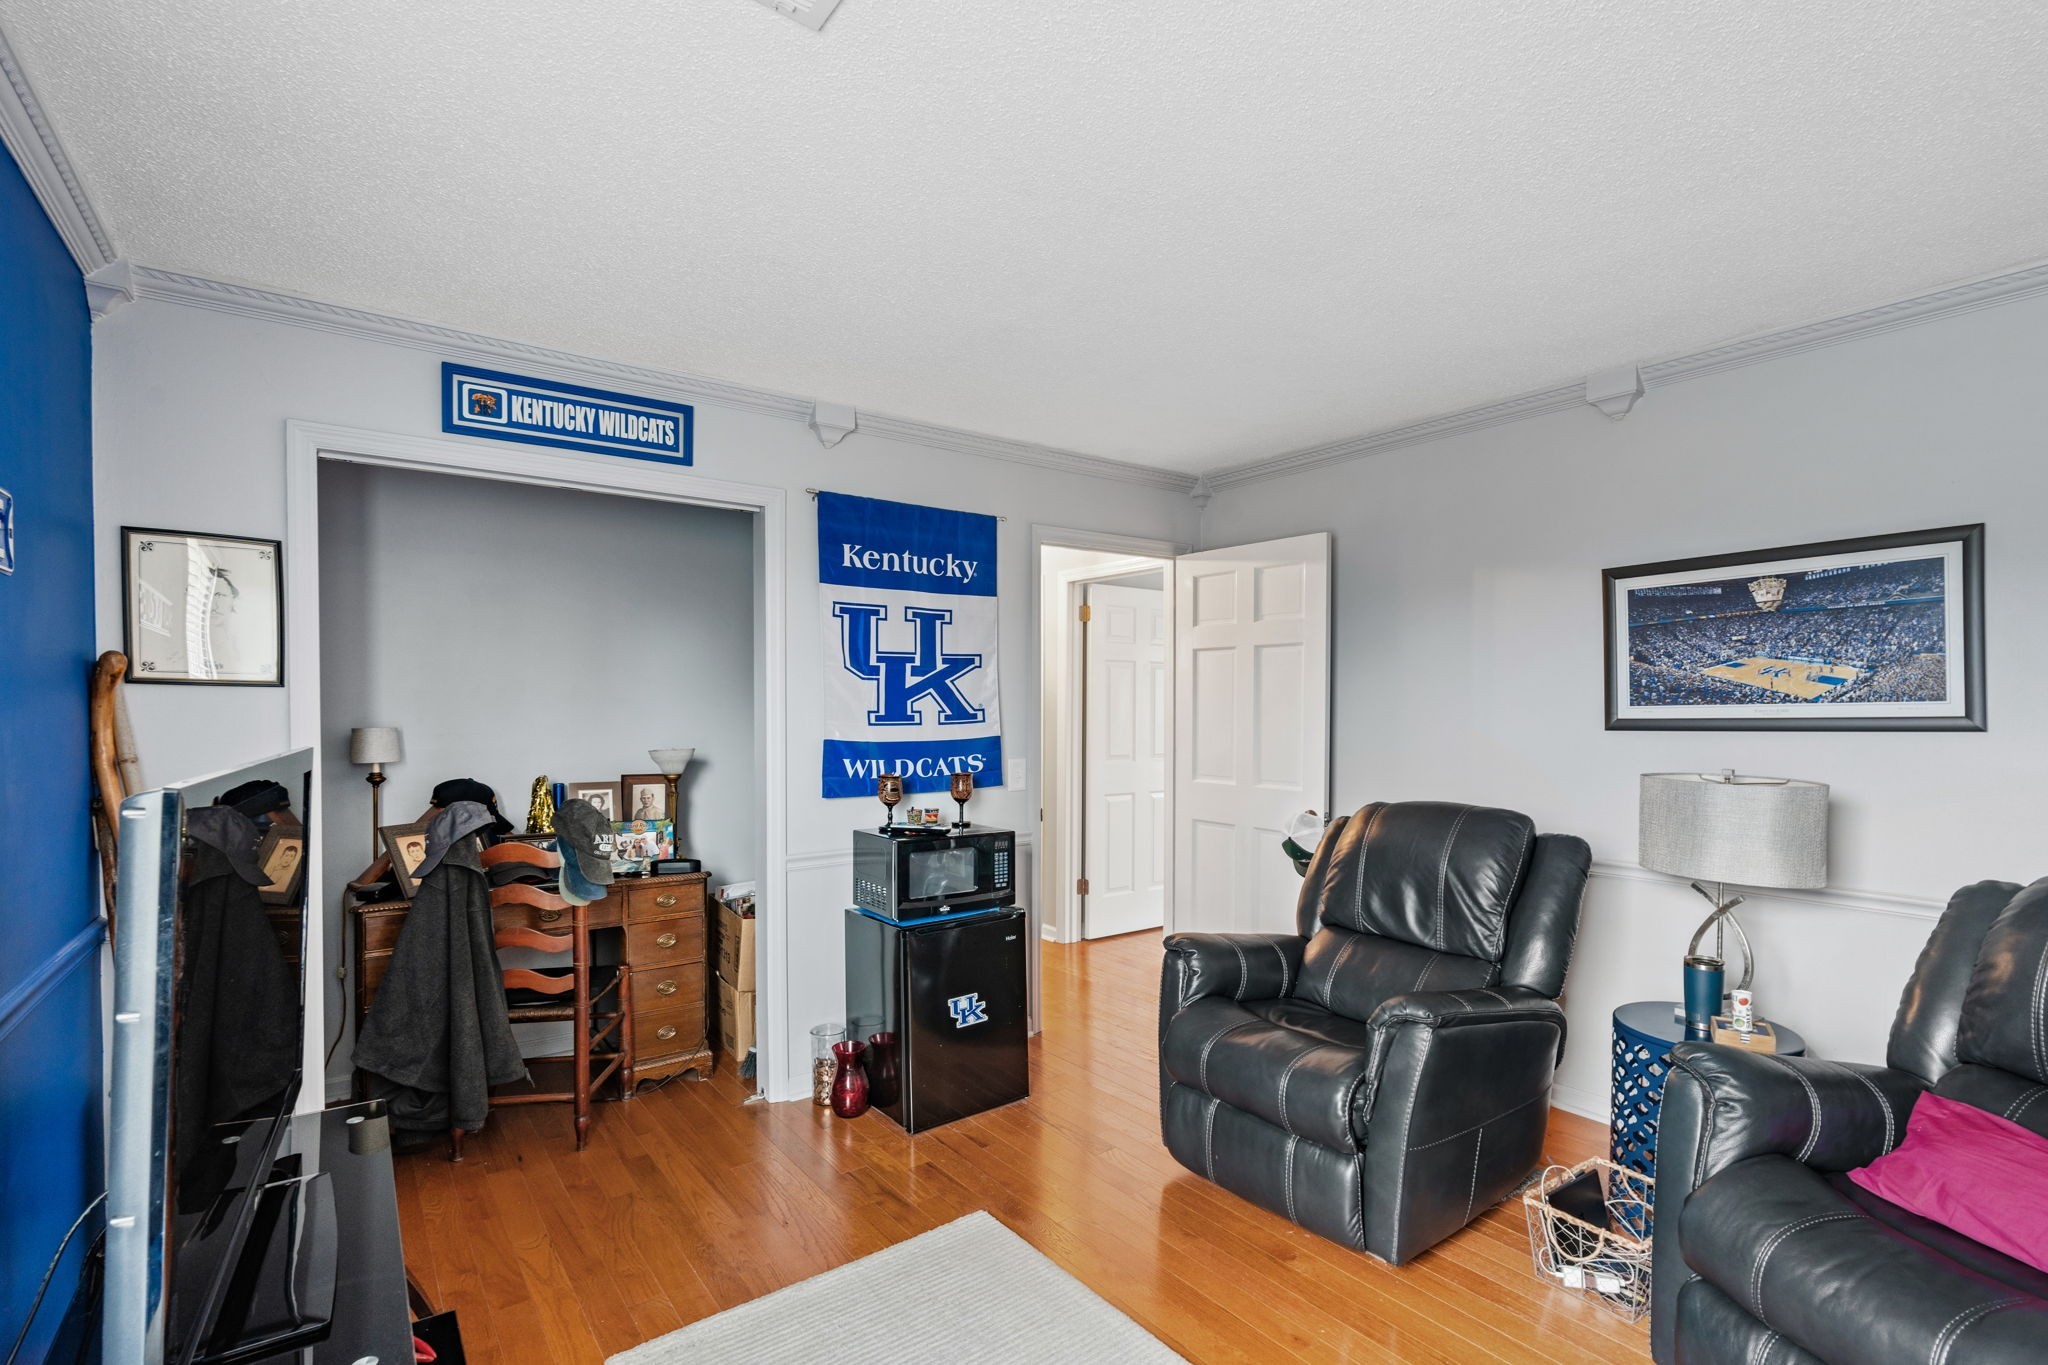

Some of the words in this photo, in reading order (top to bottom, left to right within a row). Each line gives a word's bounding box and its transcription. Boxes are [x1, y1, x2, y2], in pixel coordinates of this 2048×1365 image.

[511, 394, 596, 434] KENTUCKY
[599, 409, 675, 446] WILDCATS
[842, 543, 978, 583] Kentucky
[832, 600, 986, 727] UK
[842, 753, 985, 779] WILDCATS
[948, 992, 989, 1029] UK
